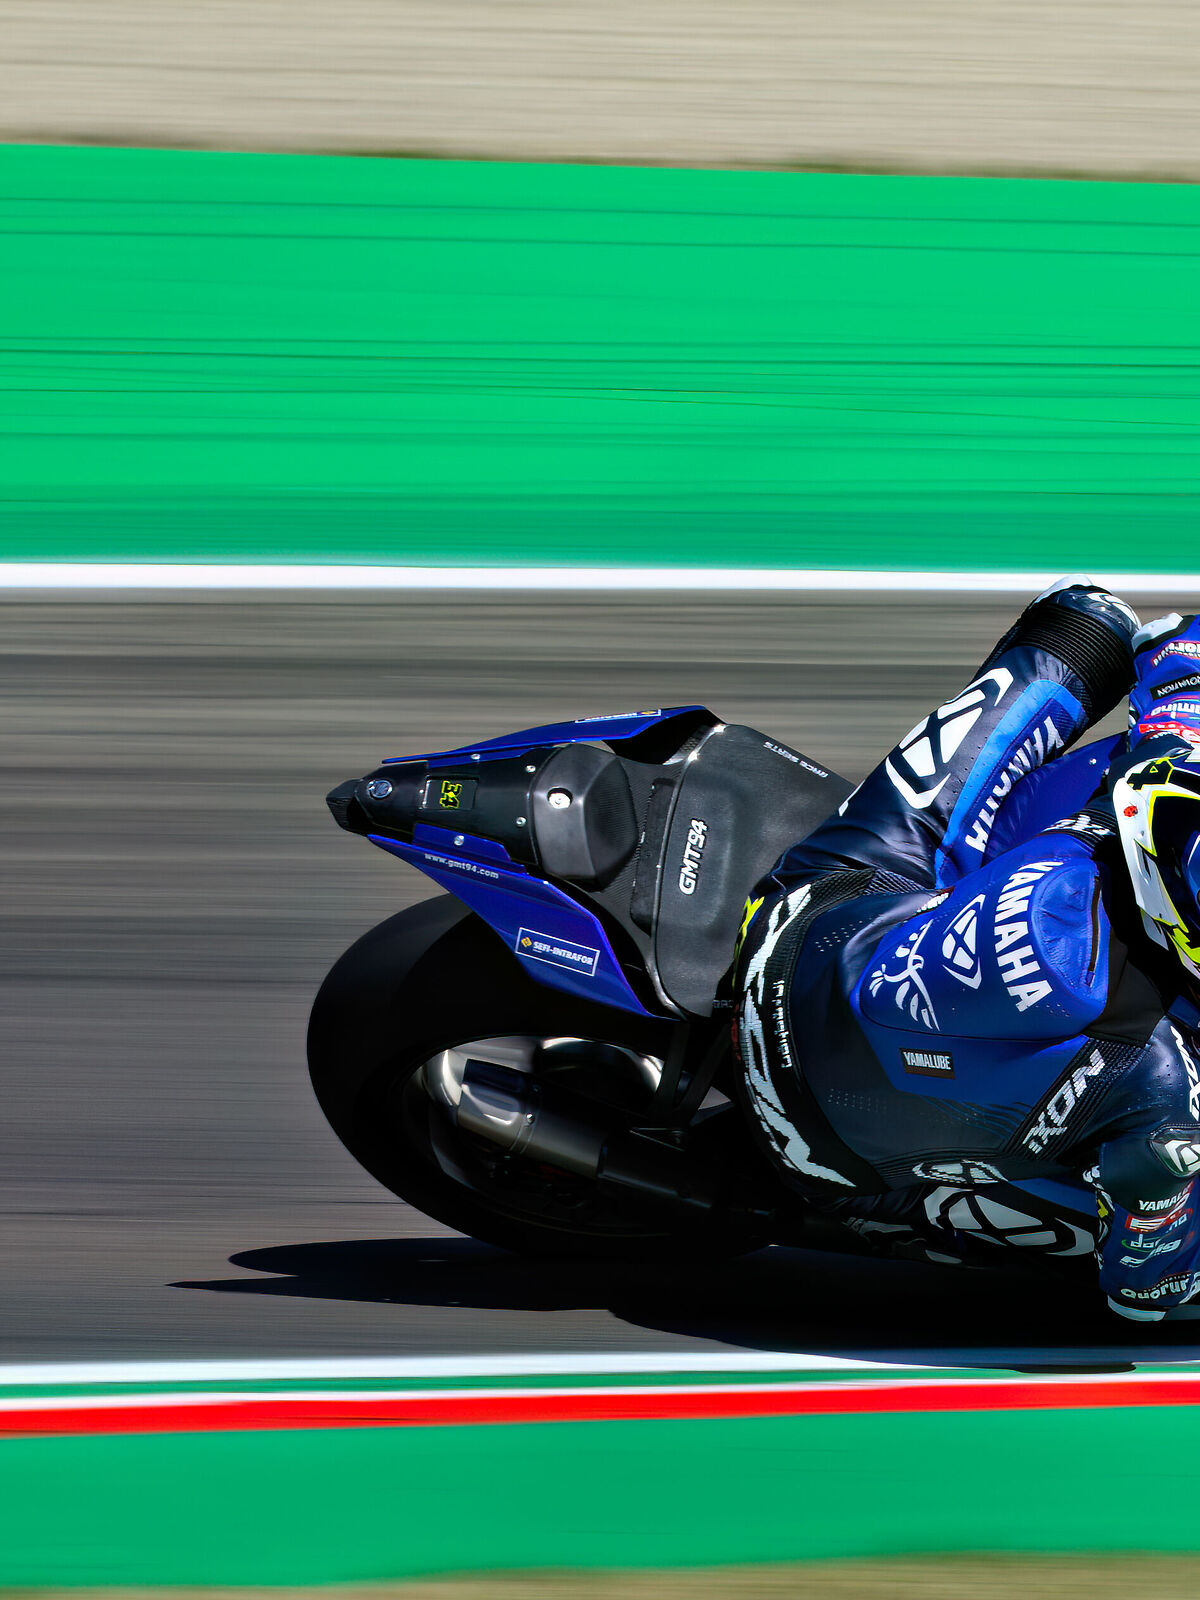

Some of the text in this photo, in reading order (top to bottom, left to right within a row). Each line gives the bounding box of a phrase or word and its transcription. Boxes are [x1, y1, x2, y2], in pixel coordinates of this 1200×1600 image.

[424, 852, 499, 879] www.gmt94.com
[679, 818, 708, 895] GMT94
[994, 861, 1064, 1012] YAMAHA
[903, 1052, 951, 1071] YAMALUBE
